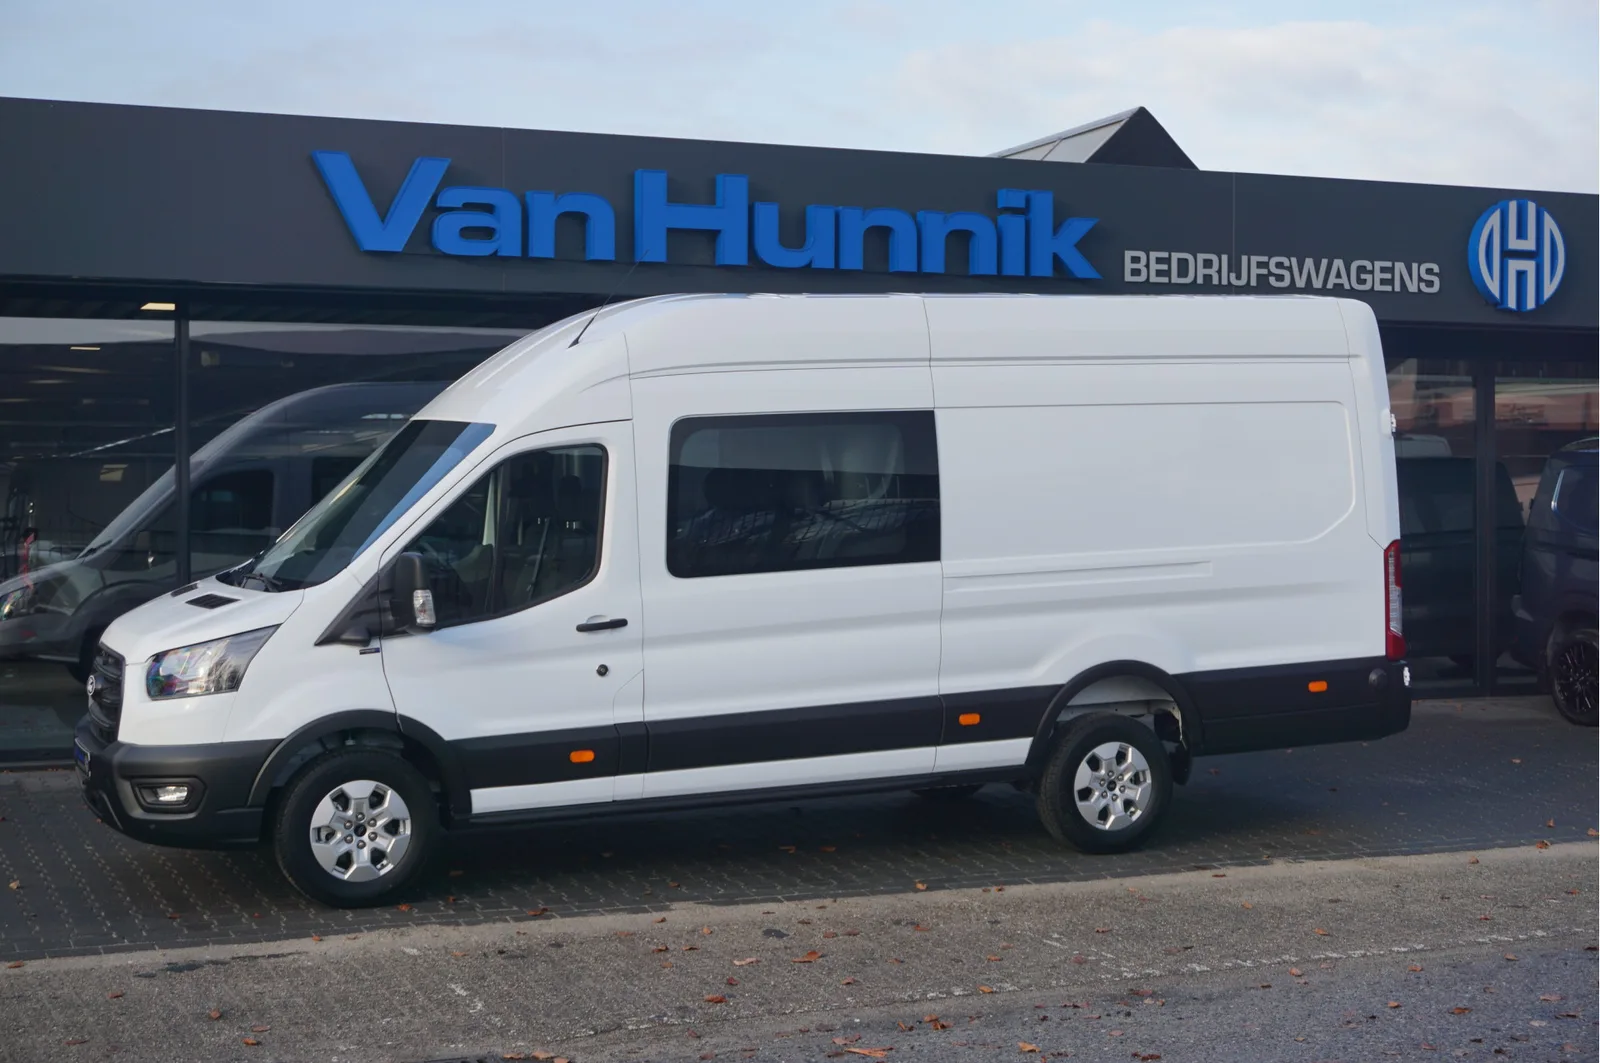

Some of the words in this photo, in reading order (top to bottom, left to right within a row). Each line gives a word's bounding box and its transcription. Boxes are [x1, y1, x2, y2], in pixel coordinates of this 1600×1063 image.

[311, 150, 615, 261] Van
[634, 169, 1102, 279] Hunnik
[1123, 250, 1441, 294] BEDRIJFSWAGENS
